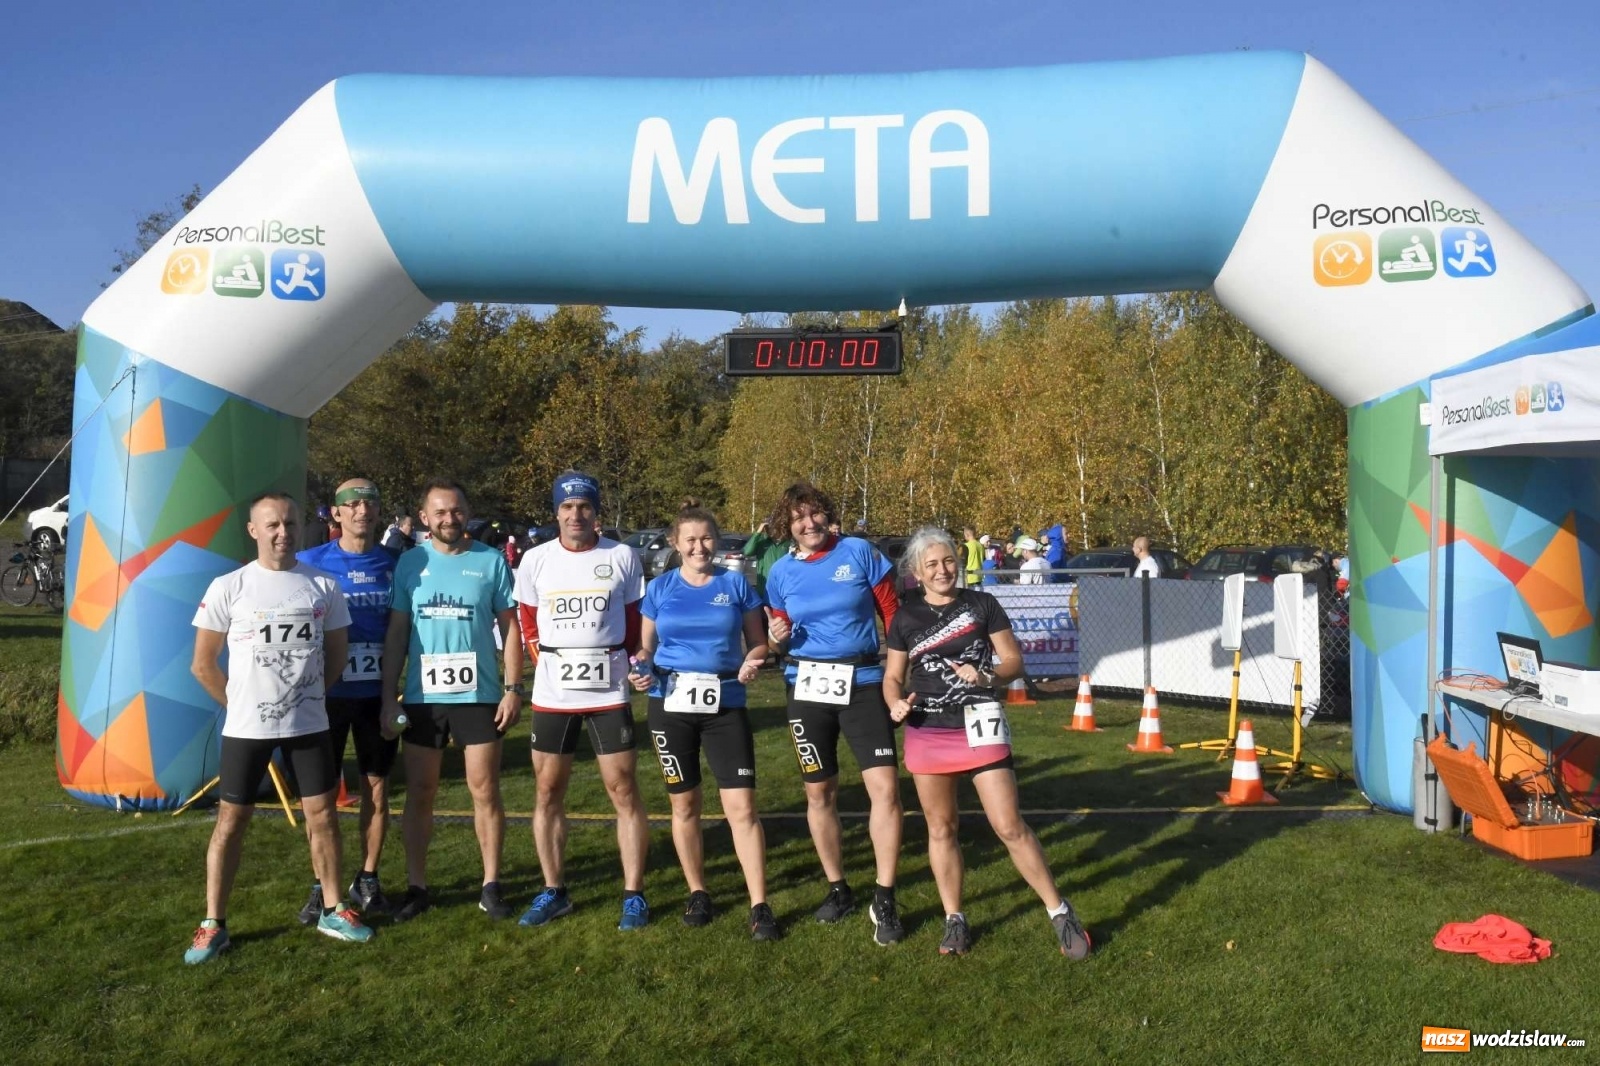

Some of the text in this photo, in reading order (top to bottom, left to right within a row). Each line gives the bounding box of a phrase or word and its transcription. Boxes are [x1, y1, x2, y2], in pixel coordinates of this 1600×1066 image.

[627, 109, 990, 225] META
[1312, 199, 1485, 229] PersonalBest
[173, 219, 326, 246] PersonalBest
[755, 340, 879, 368] 0:00:00
[1441, 396, 1512, 426] PersonalBest
[259, 622, 313, 643] 174
[426, 667, 474, 686] 130
[561, 662, 604, 681] 221
[801, 675, 847, 697] 133
[651, 730, 684, 781] agrol
[788, 719, 823, 769] agrol
